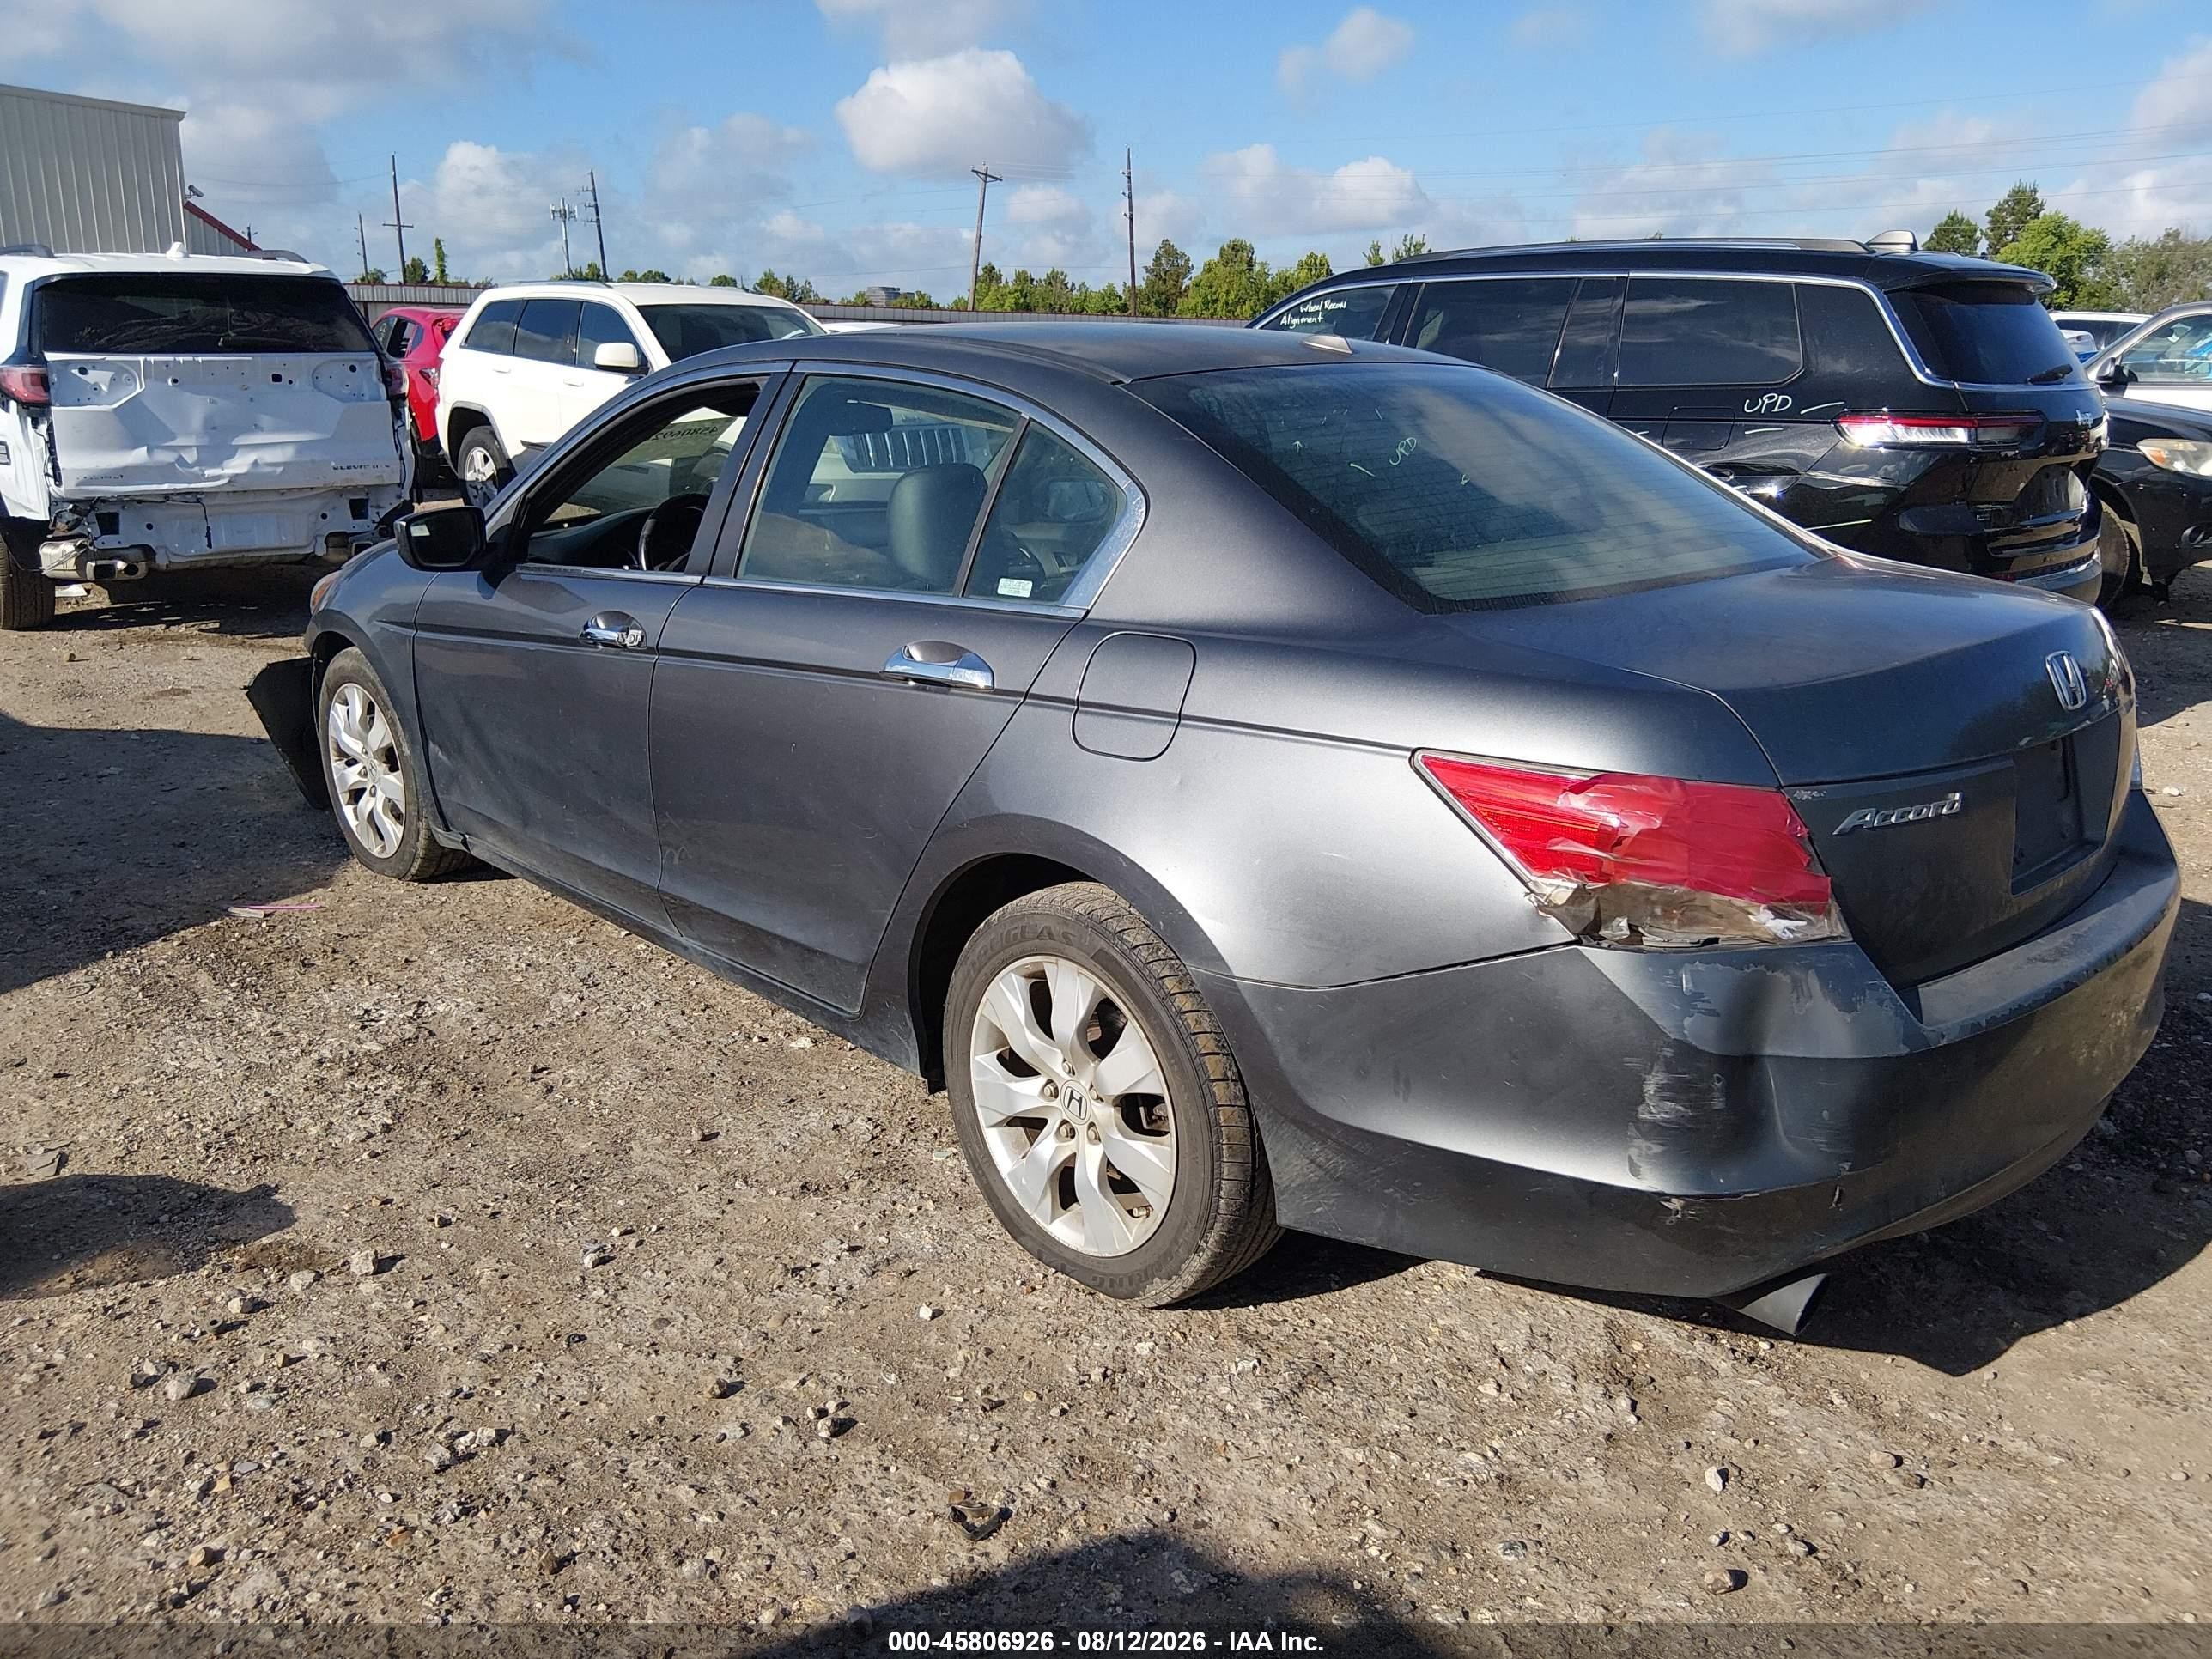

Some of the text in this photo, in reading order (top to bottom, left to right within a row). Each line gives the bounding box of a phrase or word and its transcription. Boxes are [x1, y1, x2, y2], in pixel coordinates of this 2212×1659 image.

[1280, 312, 1323, 329] Alignment
[1744, 393, 1792, 413] UPD
[1832, 792, 1963, 835] Accord
